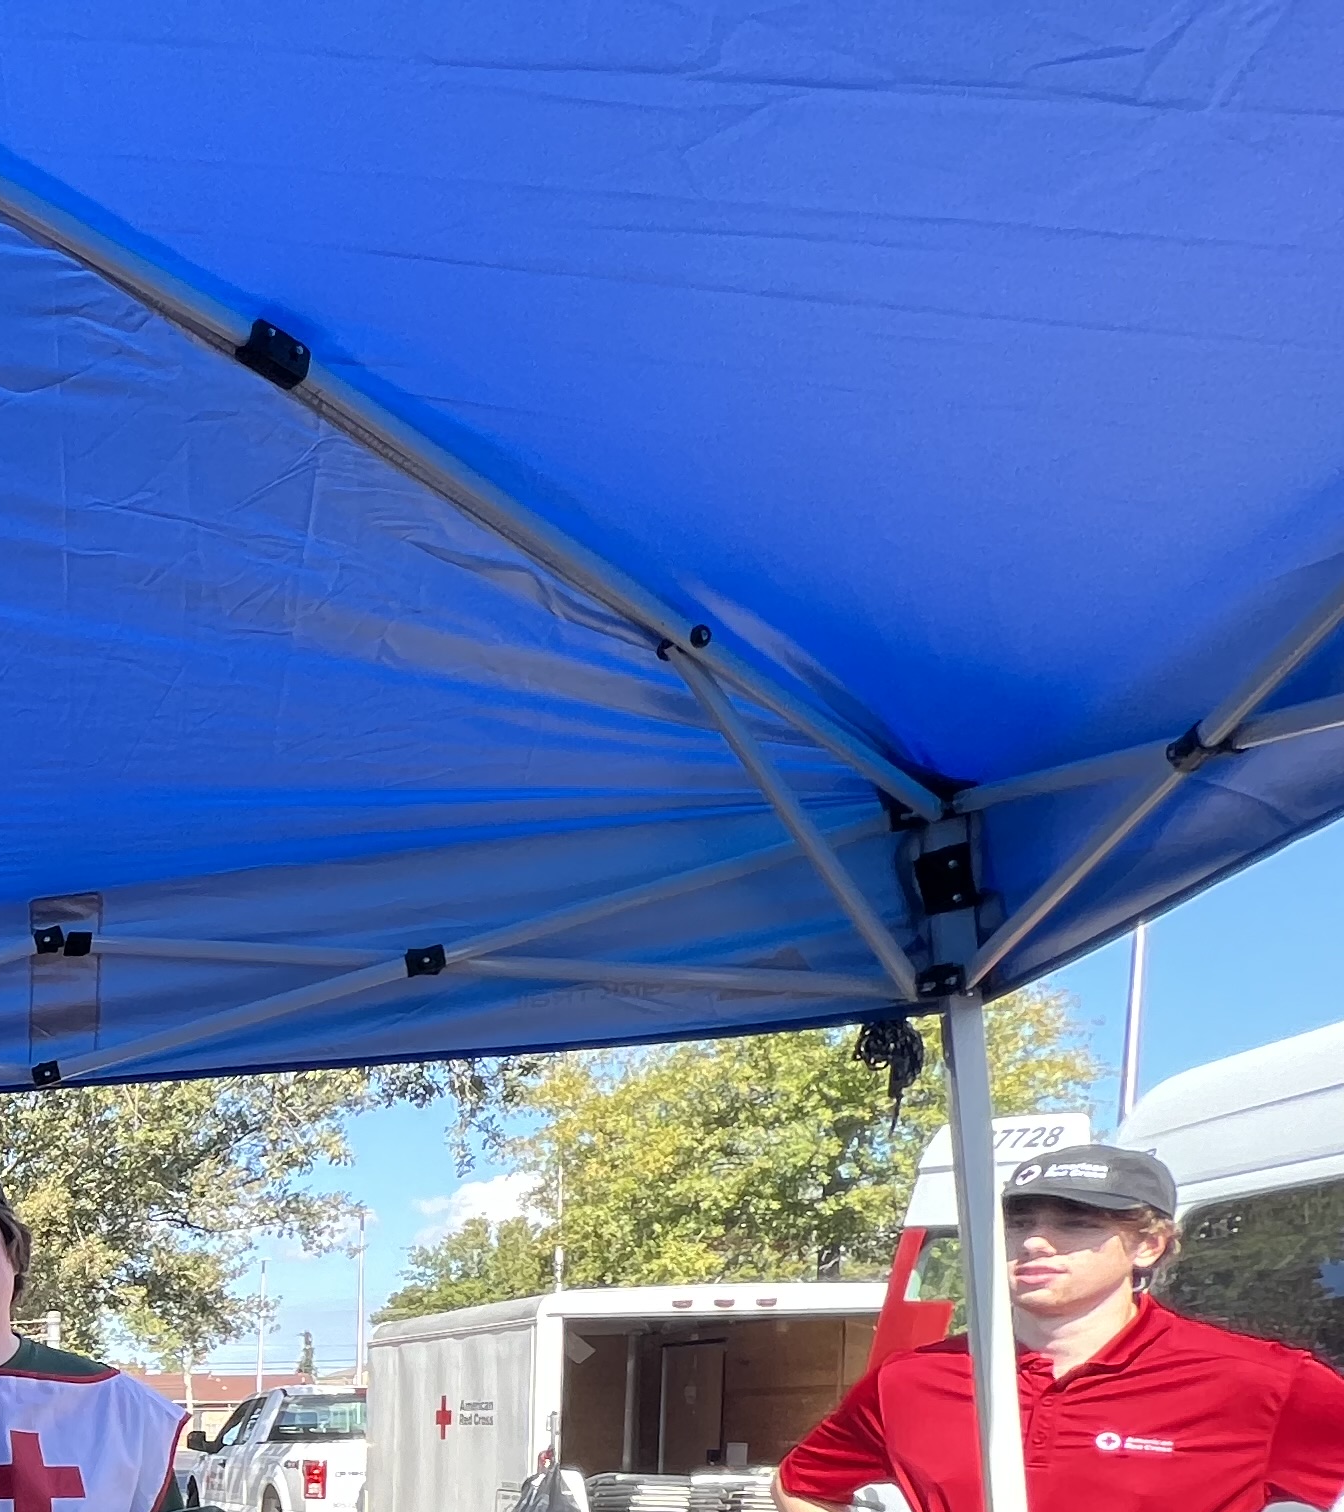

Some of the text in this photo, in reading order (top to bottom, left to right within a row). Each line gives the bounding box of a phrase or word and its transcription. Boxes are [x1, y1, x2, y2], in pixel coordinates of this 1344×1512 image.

[993, 1126, 1065, 1149] 7728
[459, 1399, 494, 1411] American
[459, 1413, 494, 1426] Red Cross
